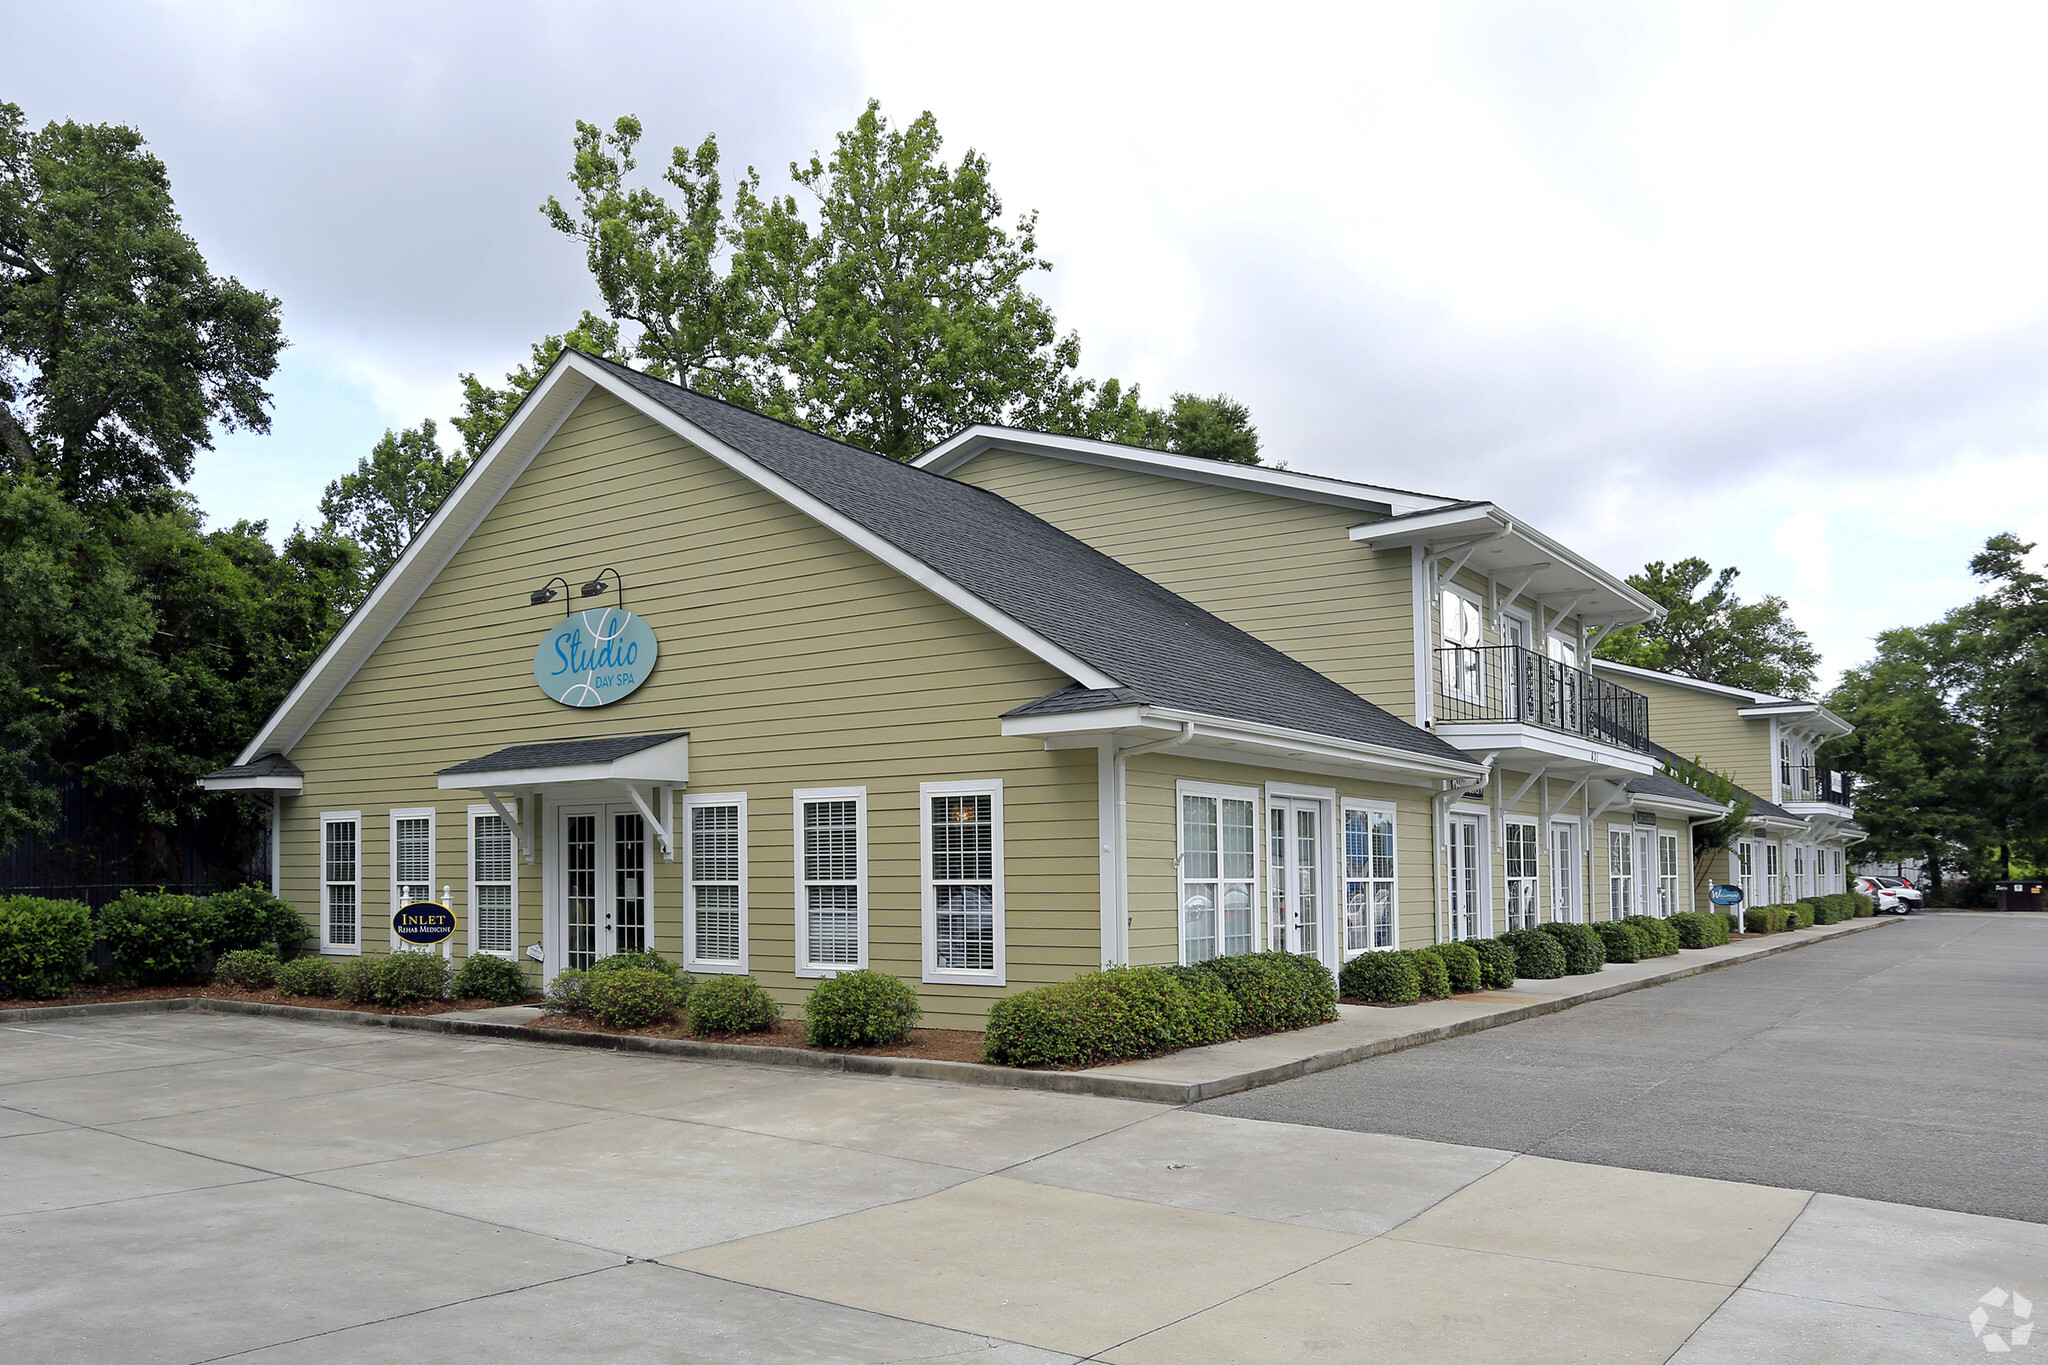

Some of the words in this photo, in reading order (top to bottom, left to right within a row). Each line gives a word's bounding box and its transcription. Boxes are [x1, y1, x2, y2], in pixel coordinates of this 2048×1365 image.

[551, 617, 638, 676] Studio
[596, 675, 614, 689] DAY
[616, 673, 635, 686] SPA
[402, 914, 446, 925] INLET
[398, 925, 418, 934] REHAB
[419, 925, 451, 933] MEDICINE
